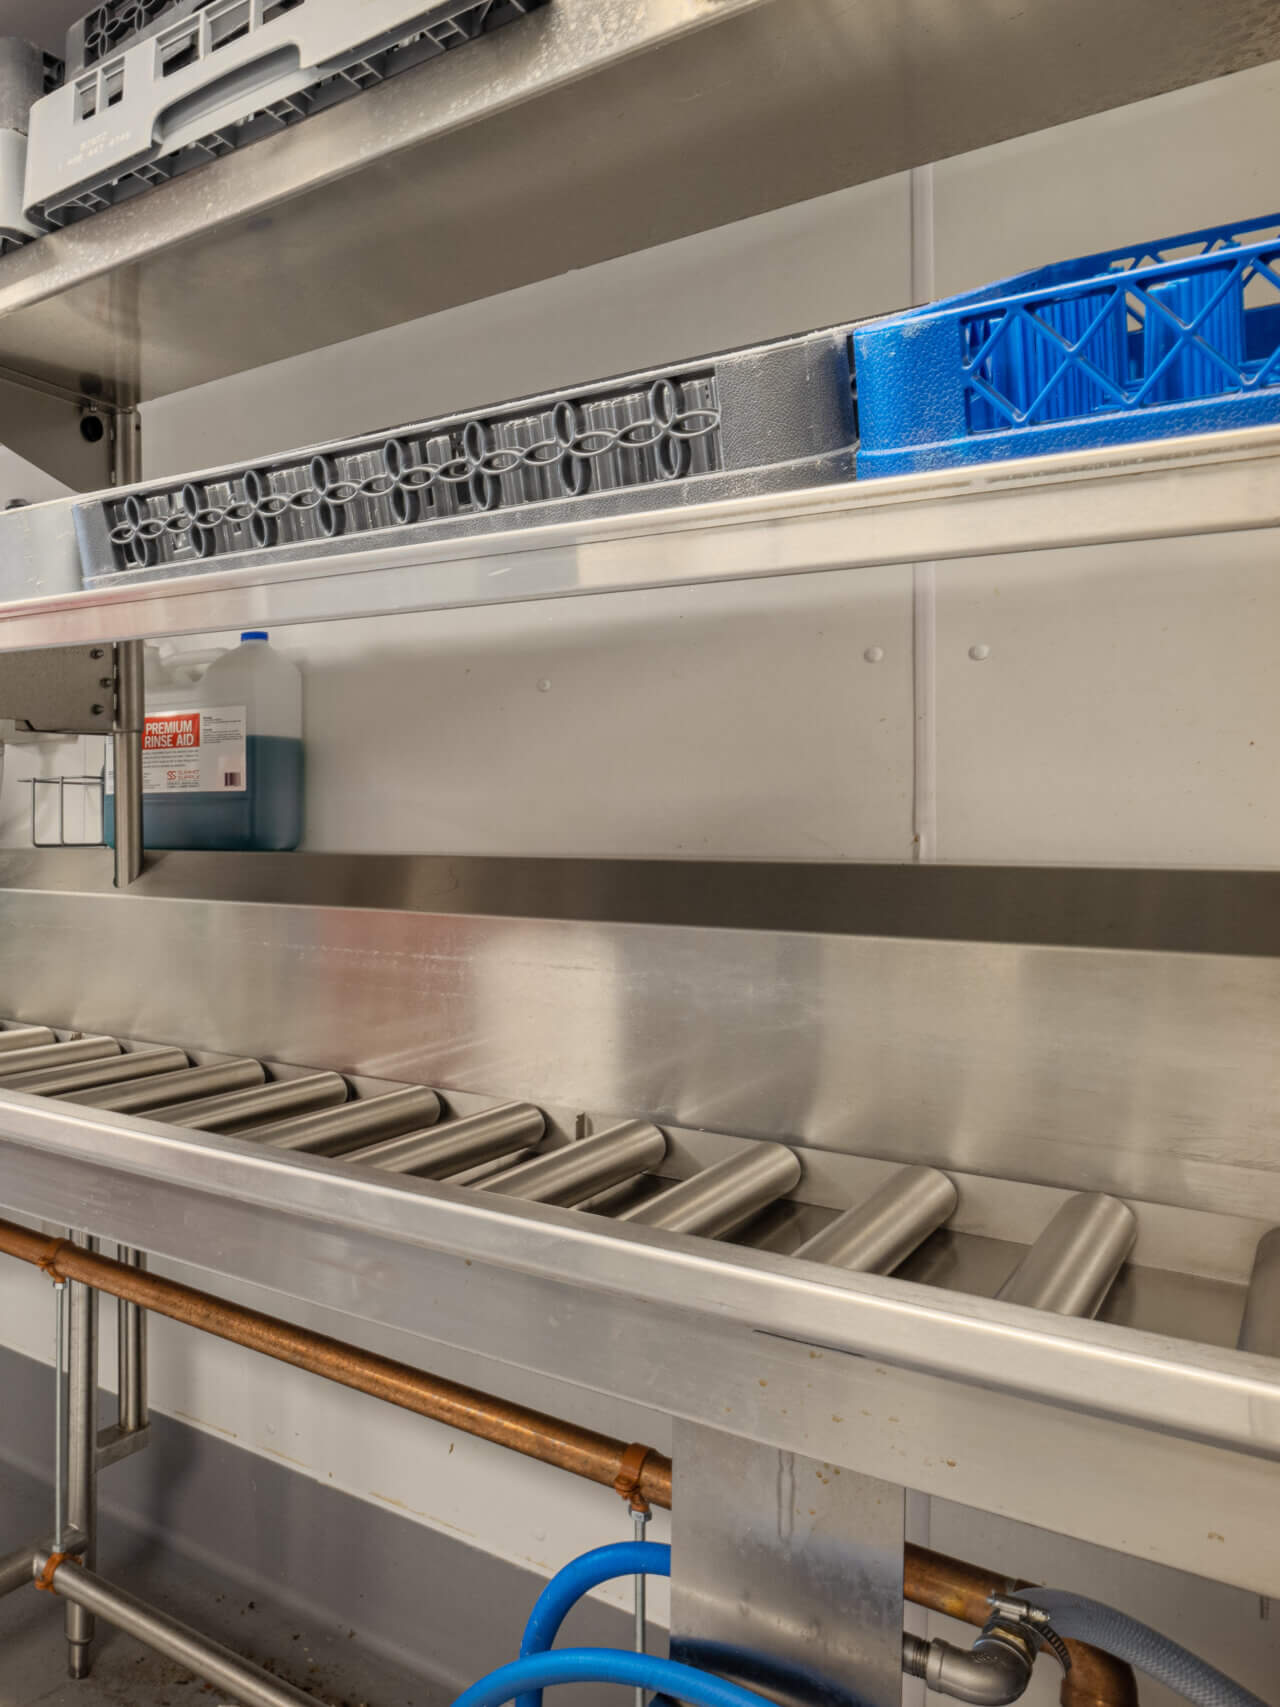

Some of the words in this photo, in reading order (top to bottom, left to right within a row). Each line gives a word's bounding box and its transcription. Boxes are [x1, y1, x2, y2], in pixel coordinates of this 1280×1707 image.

[145, 720, 193, 735] PREMIUM
[144, 735, 174, 748] RINSE
[176, 733, 195, 747] AID
